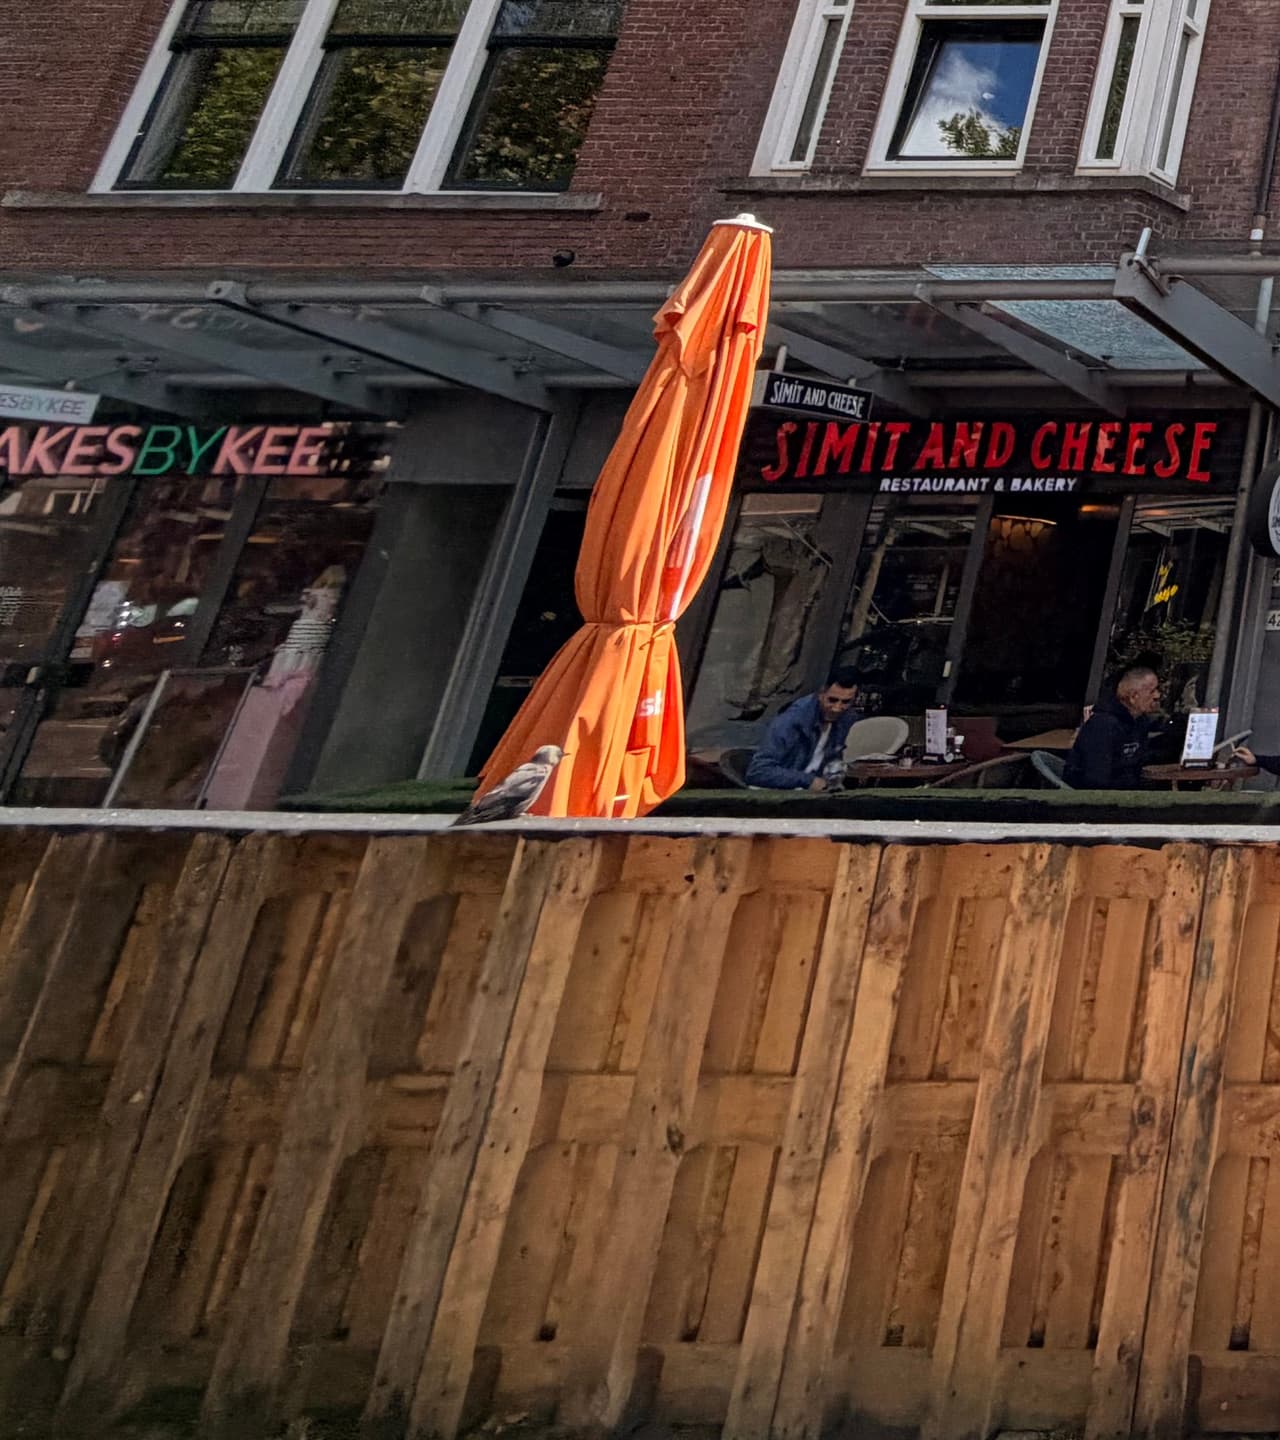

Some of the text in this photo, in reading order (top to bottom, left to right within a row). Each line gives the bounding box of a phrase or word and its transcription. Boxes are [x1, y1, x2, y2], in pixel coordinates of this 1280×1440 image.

[801, 387, 827, 407] AND
[827, 391, 865, 418] CHEESE
[761, 422, 1218, 482] SIMIT AND CHEESE
[880, 477, 1077, 492] RESTAURANT & BAKERY
